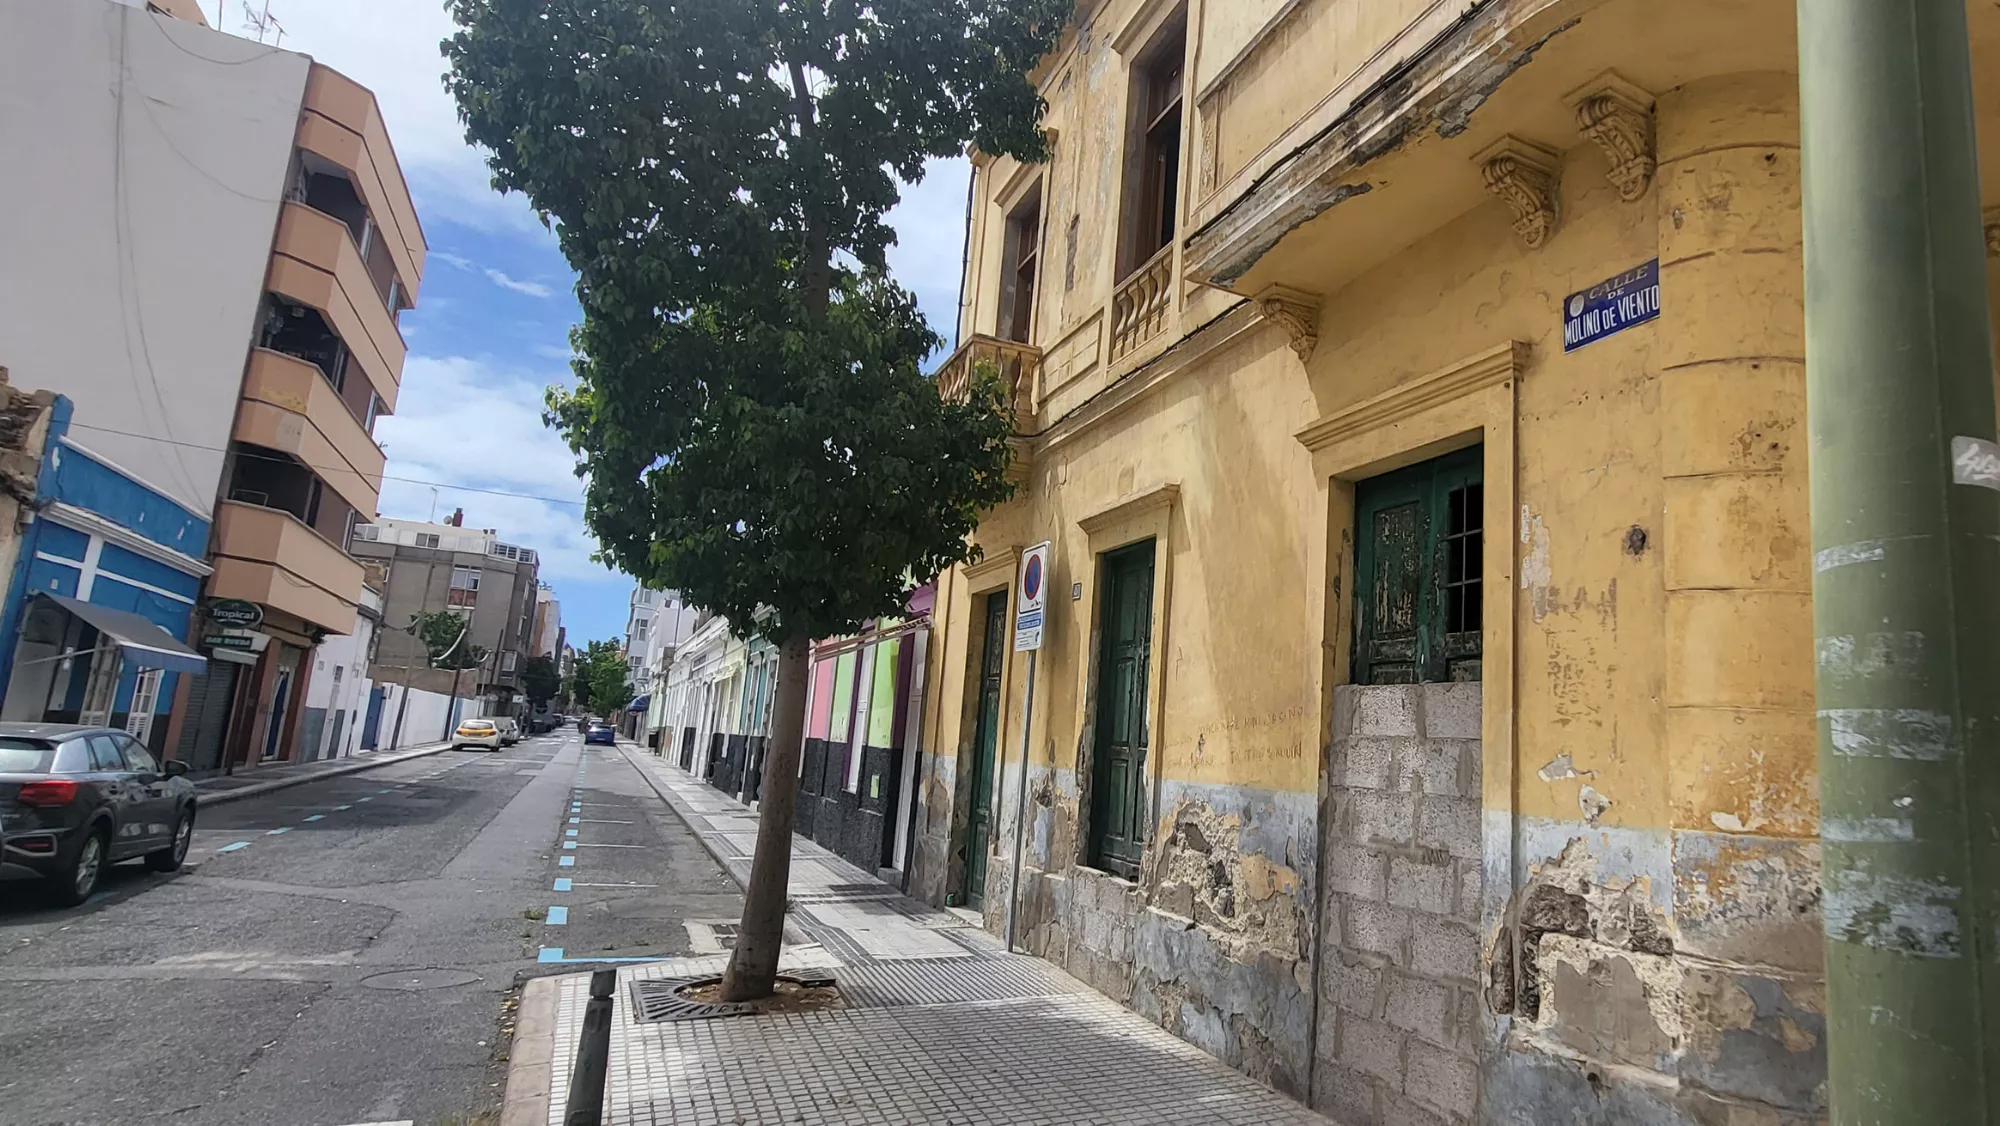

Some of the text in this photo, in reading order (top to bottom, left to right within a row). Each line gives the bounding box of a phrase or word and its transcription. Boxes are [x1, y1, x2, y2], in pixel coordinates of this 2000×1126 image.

[1588, 265, 1648, 300] CALLE
[1607, 287, 1625, 300] DE
[1564, 284, 1660, 347] MOLINO DE VIENTO
[212, 608, 255, 620] Tropical
